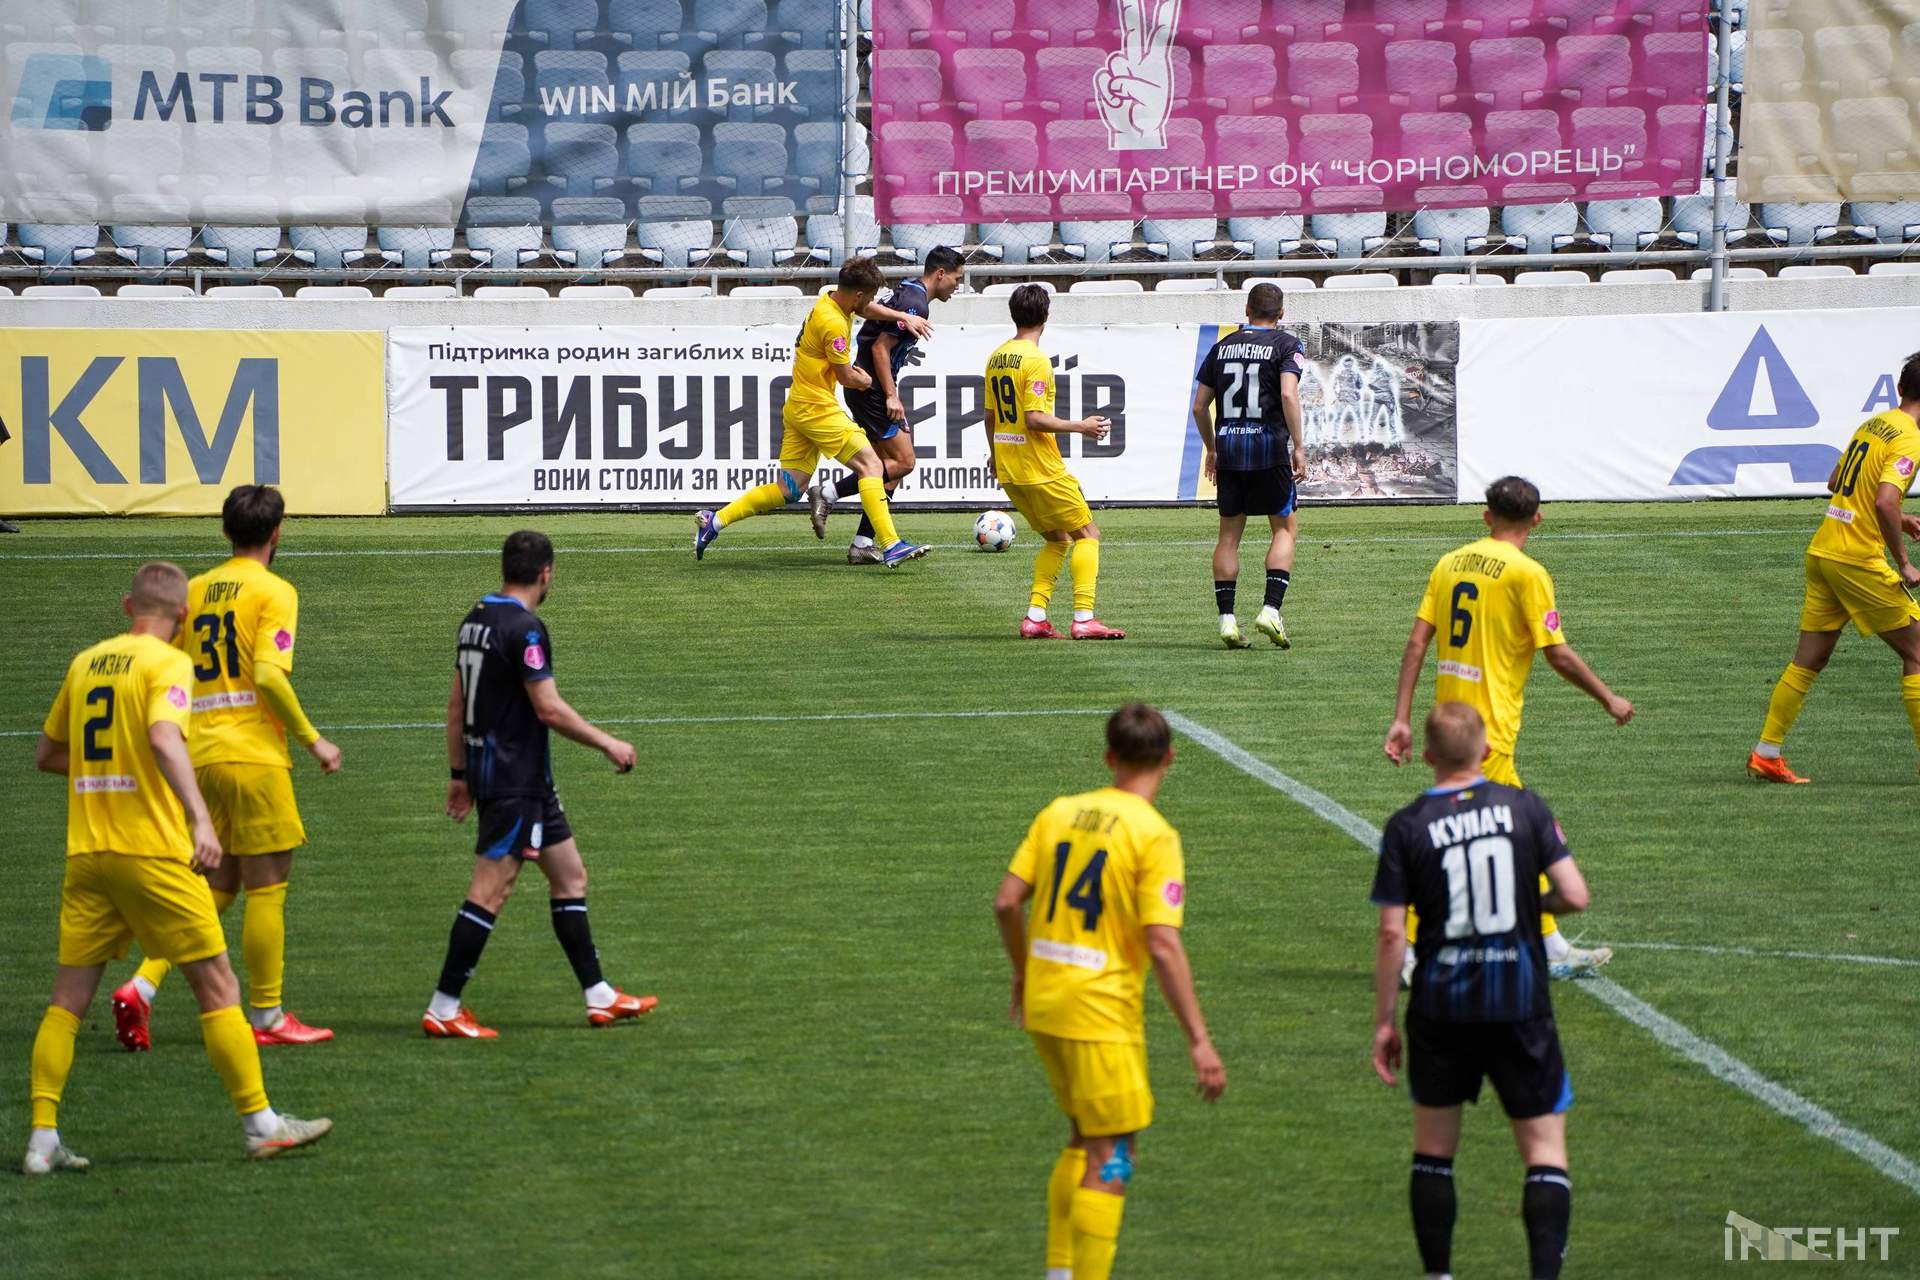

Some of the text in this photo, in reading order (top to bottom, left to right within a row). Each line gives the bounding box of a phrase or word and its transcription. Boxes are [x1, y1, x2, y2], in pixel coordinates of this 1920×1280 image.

[133, 69, 456, 128] MTB Bank
[540, 71, 799, 117] WIN МІЙ Банк
[937, 164, 1259, 196] ПРЕМІУМПАРТНЕР
[1270, 162, 1322, 189] ФК
[428, 343, 791, 364] Підтримка родин загиблих від:
[1217, 343, 1273, 360] КЛИМЕНКО
[991, 376, 1017, 424] 19
[1223, 362, 1262, 418] 21
[534, 469, 590, 491] ВОНИ
[599, 468, 683, 491] СТОЯЛИ
[691, 468, 718, 490] ЗА
[919, 467, 1002, 490] КОМАН
[1834, 439, 1870, 497] 10
[1450, 581, 1479, 648] 6
[193, 611, 241, 682] 31
[84, 686, 115, 762] 2
[1427, 805, 1513, 849] КУЛАЧ
[1047, 842, 1108, 932] 14
[1441, 836, 1516, 940] 10
